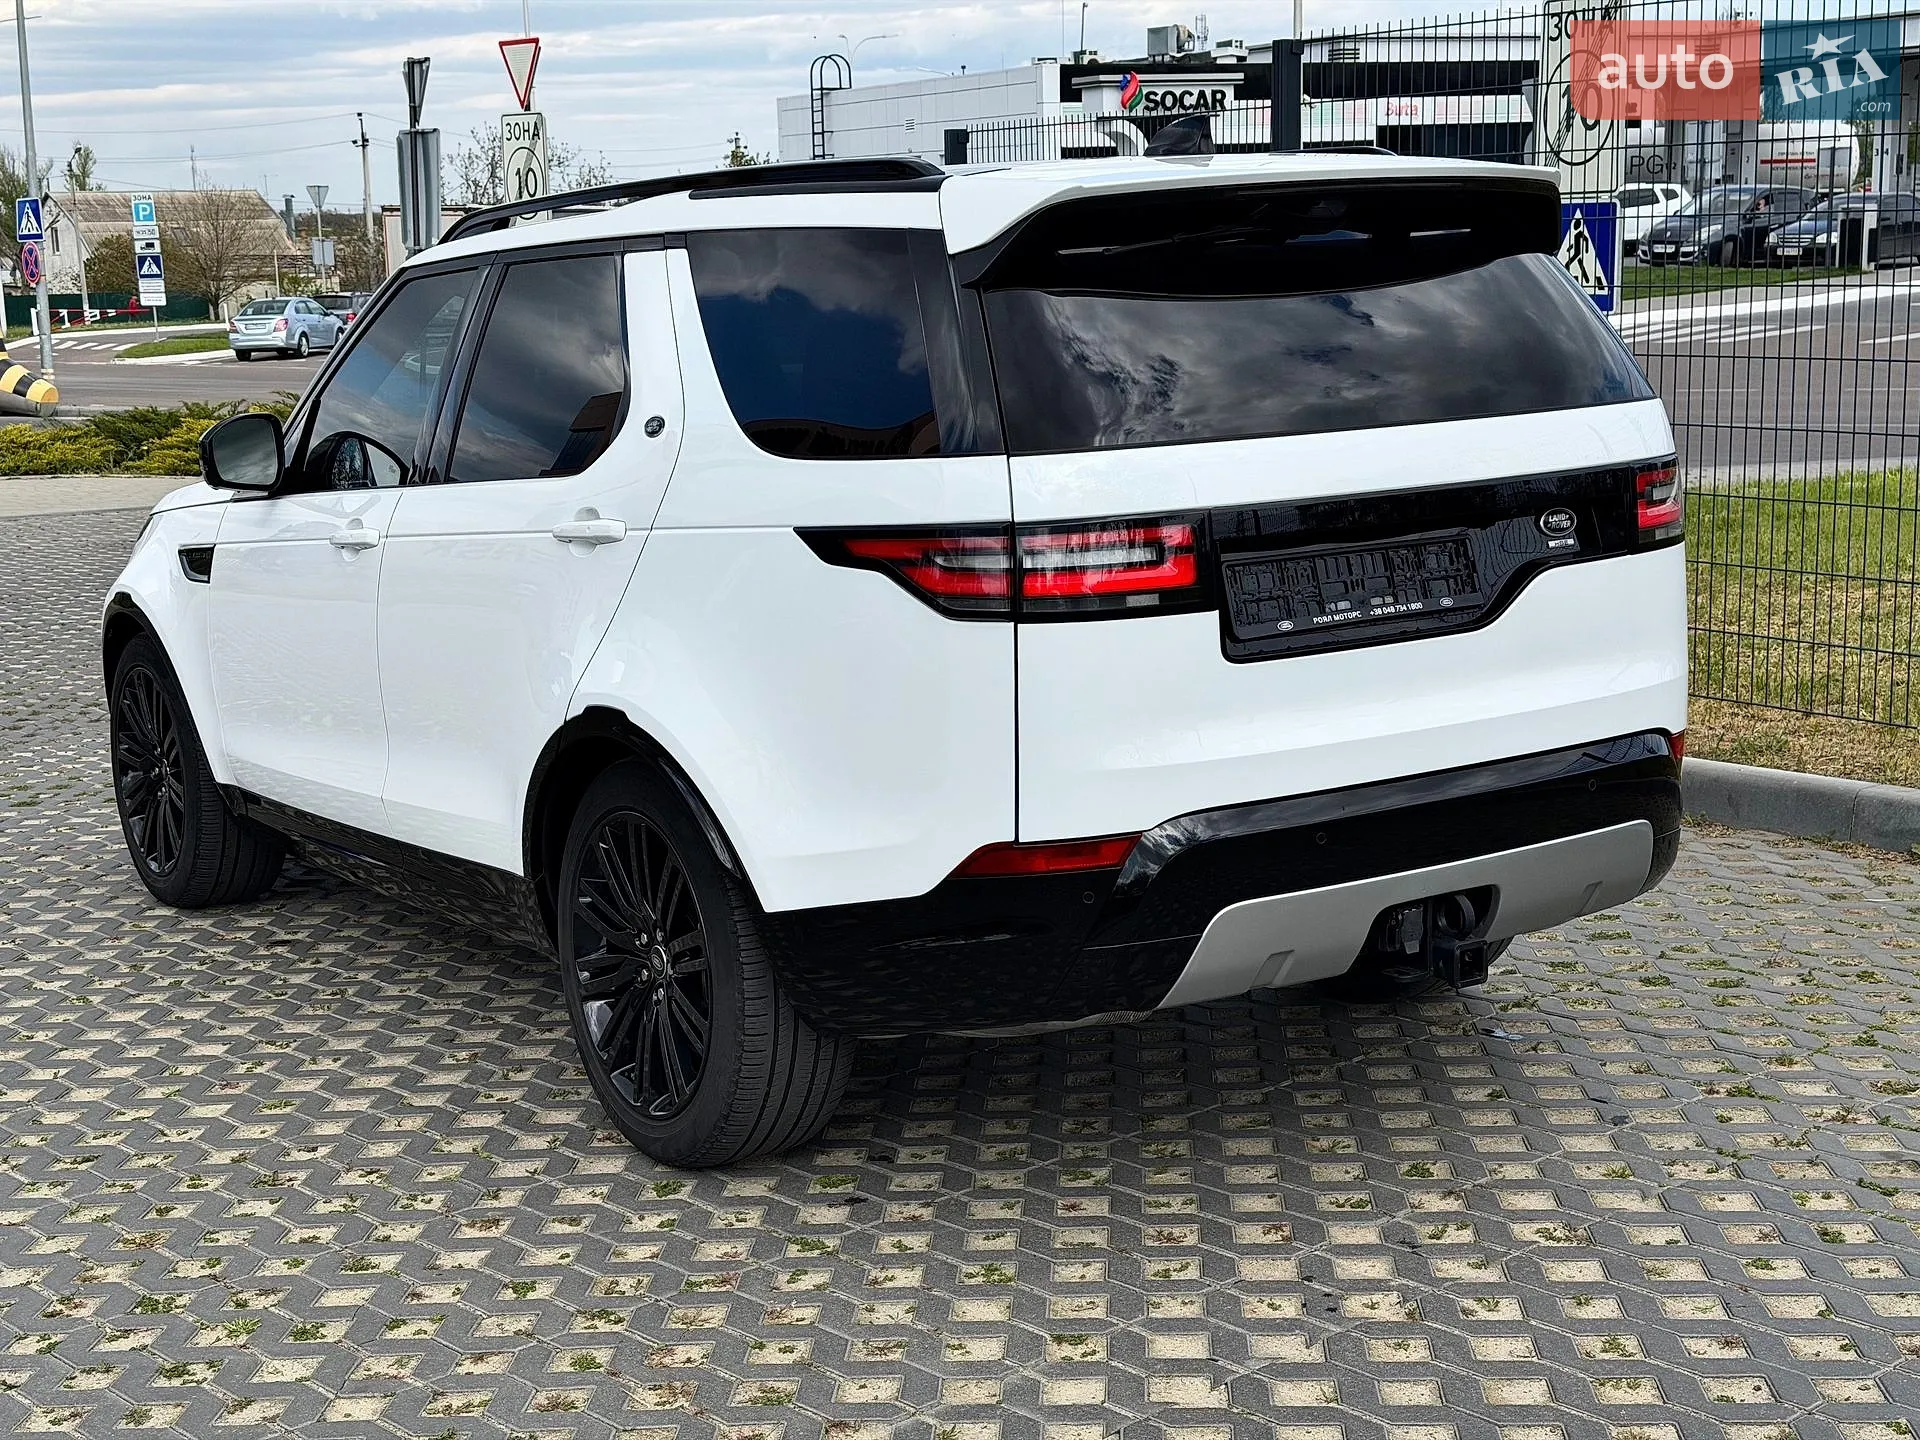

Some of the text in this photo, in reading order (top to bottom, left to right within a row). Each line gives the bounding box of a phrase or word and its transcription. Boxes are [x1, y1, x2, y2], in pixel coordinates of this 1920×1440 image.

[1143, 89, 1227, 112] SOCAR
[505, 121, 541, 142] ЗОНА
[515, 167, 538, 200] 10
[132, 194, 152, 202] ЗОНА
[138, 204, 151, 221] P
[1312, 610, 1362, 625] РОЯЛ МОТОРС
[1369, 602, 1423, 616] +38 048 734 1800
